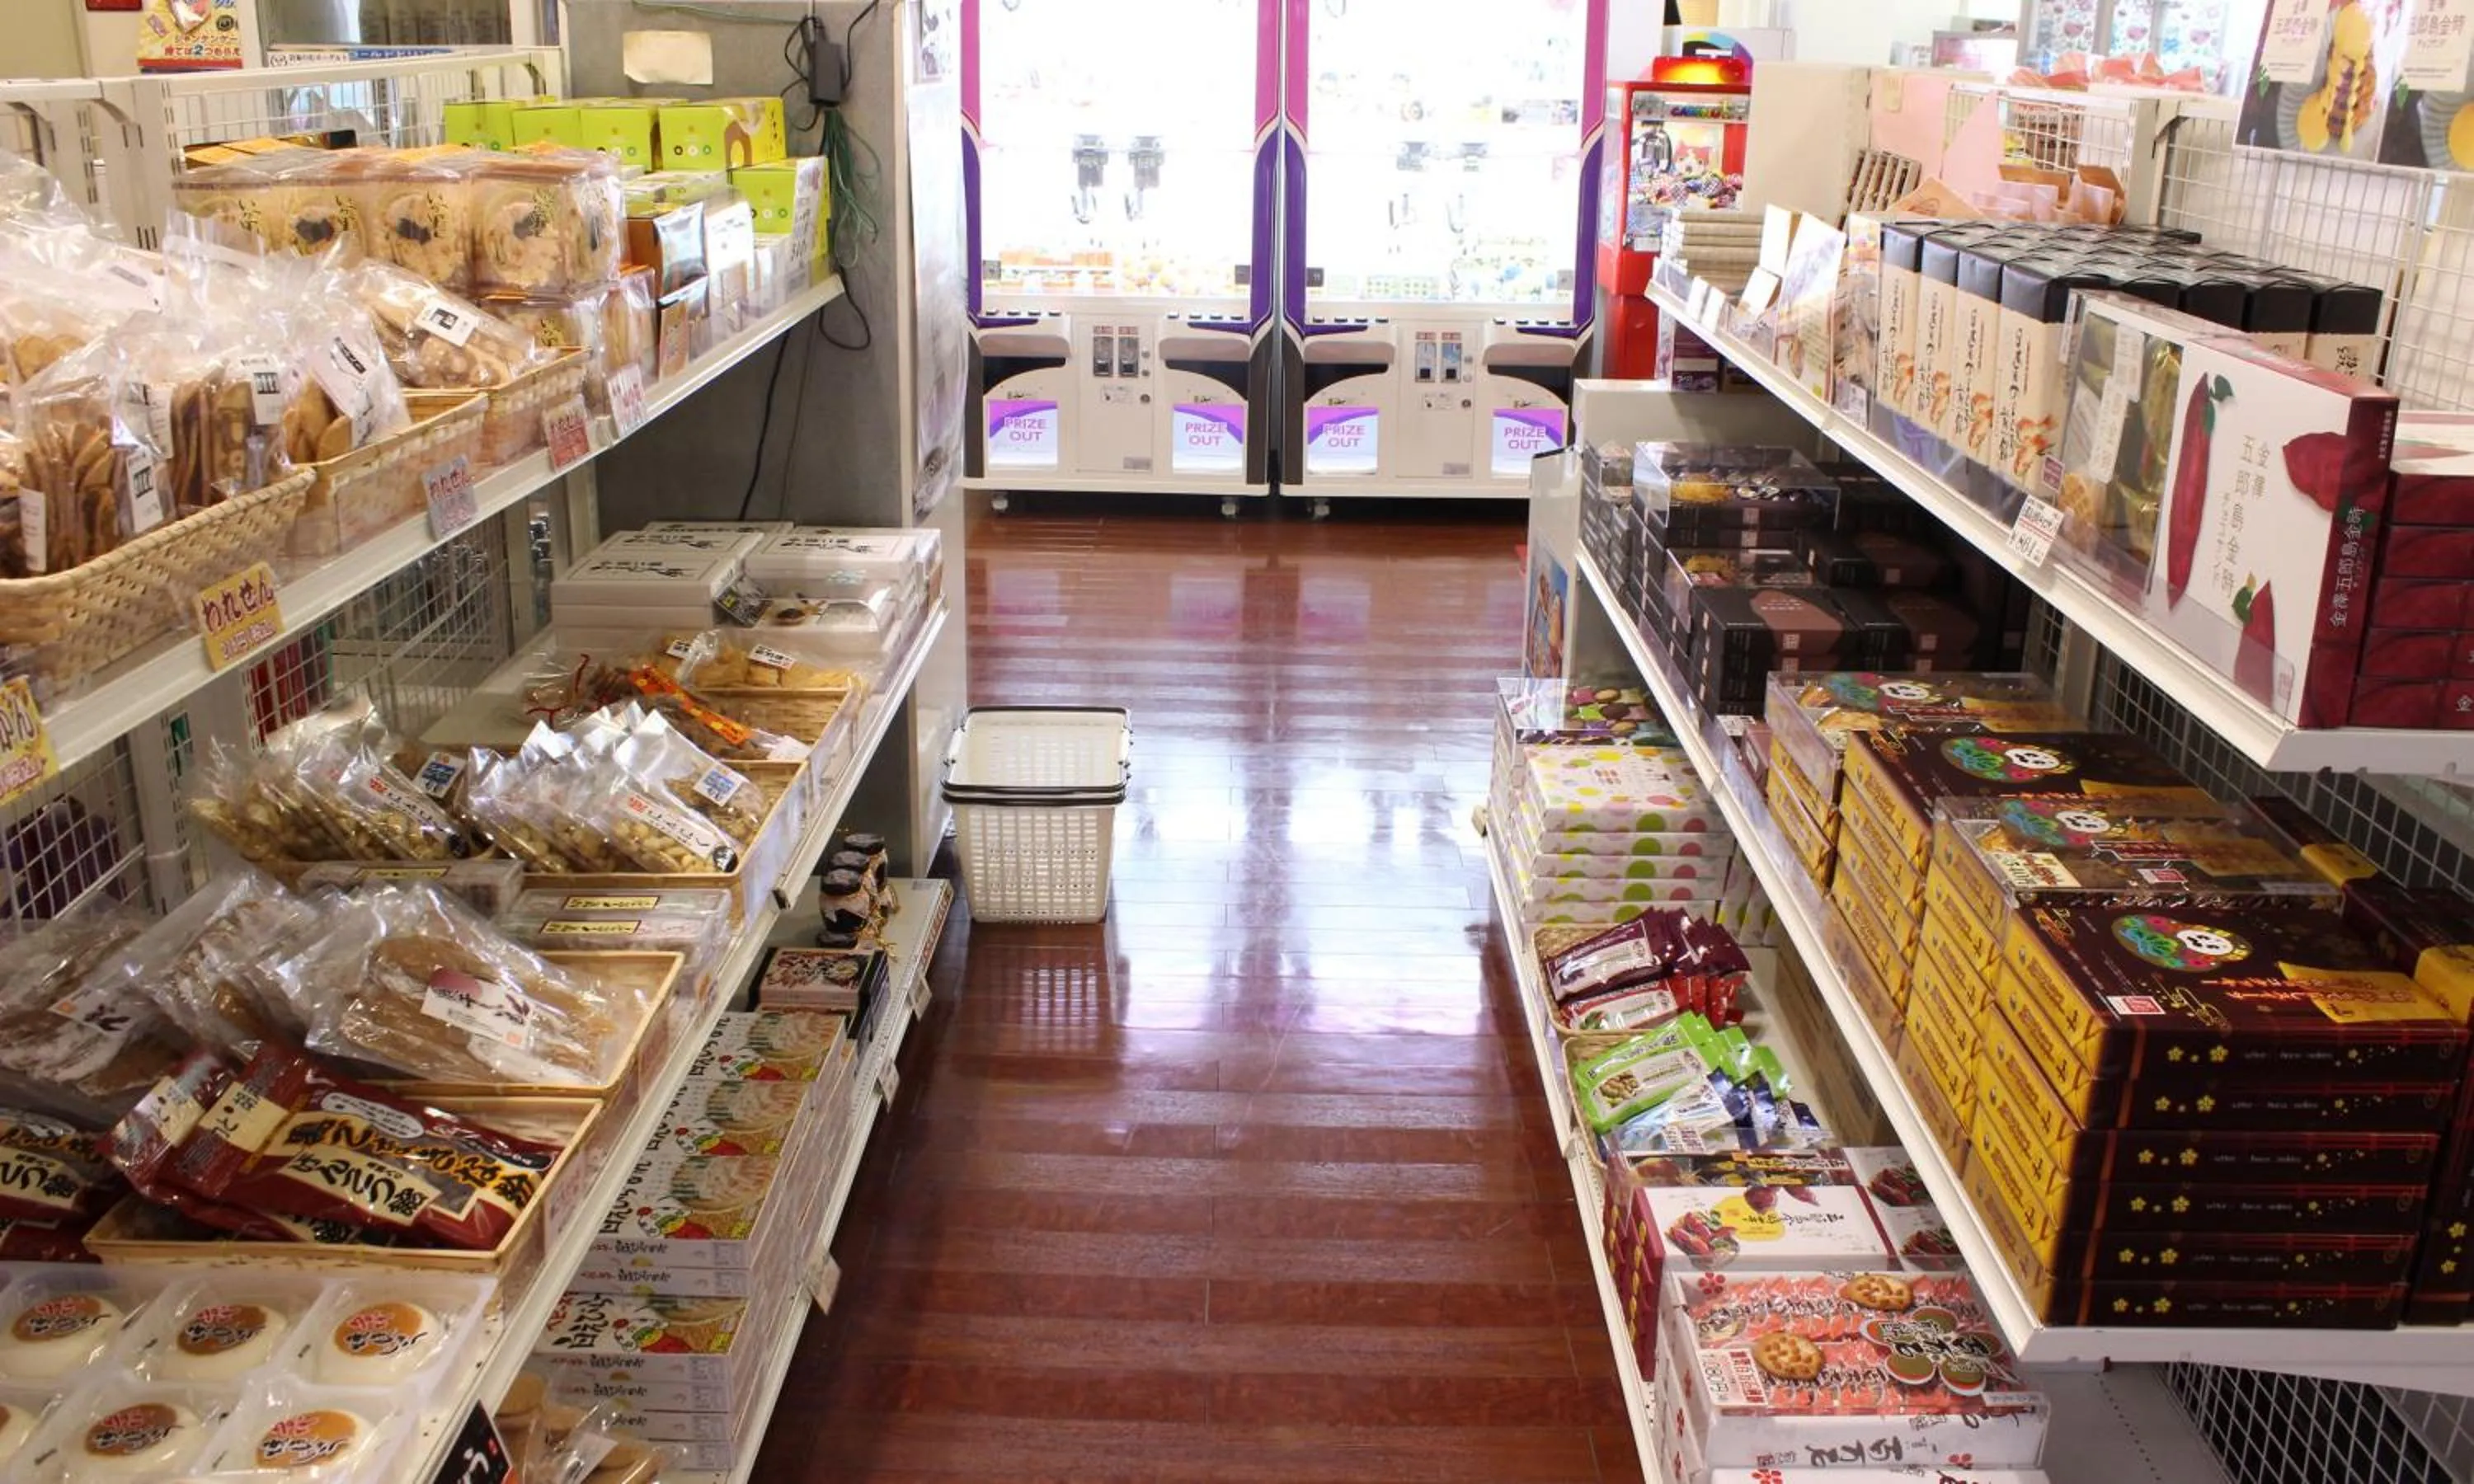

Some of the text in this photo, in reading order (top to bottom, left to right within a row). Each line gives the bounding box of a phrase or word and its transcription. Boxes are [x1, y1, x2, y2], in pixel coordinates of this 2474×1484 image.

[1004, 418, 1047, 430] PRIZE
[1184, 422, 1227, 434] PRIZE
[1324, 424, 1366, 436] PRIZE
[1009, 430, 1043, 442] OUT
[1503, 426, 1545, 438] PRIZE
[1188, 434, 1222, 446] OUT
[1328, 437, 1361, 448] OUT
[1507, 439, 1541, 450] OUT
[201, 571, 275, 633] われせん
